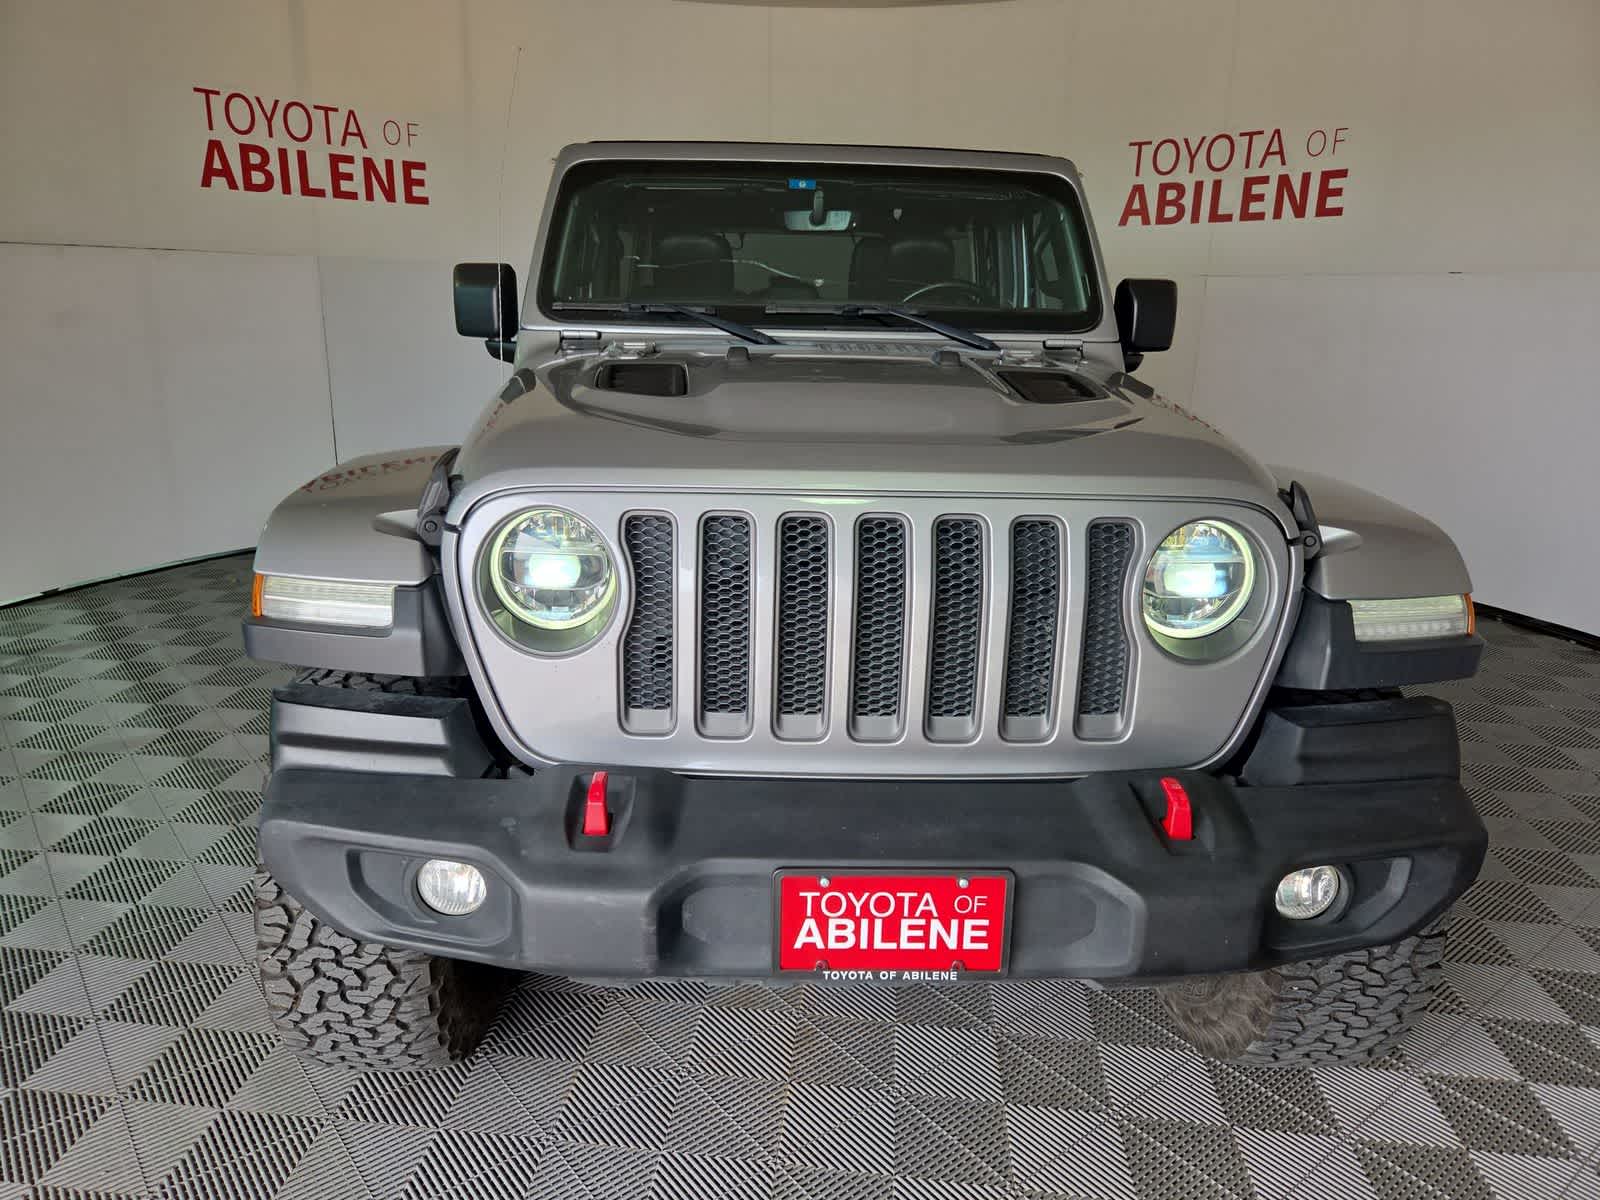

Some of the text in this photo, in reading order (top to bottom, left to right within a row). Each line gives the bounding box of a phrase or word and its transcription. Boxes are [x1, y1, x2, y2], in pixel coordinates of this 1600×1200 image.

[193, 87, 420, 149] TOYOTA OF
[201, 139, 430, 205] ABILENE
[1128, 127, 1349, 177] TOYOTA OF
[1118, 168, 1349, 227] ABILENE
[799, 891, 988, 918] TOYOTA OF
[793, 918, 990, 950] ABILENE
[823, 971, 958, 981] TOYOTA OF ABILENE
